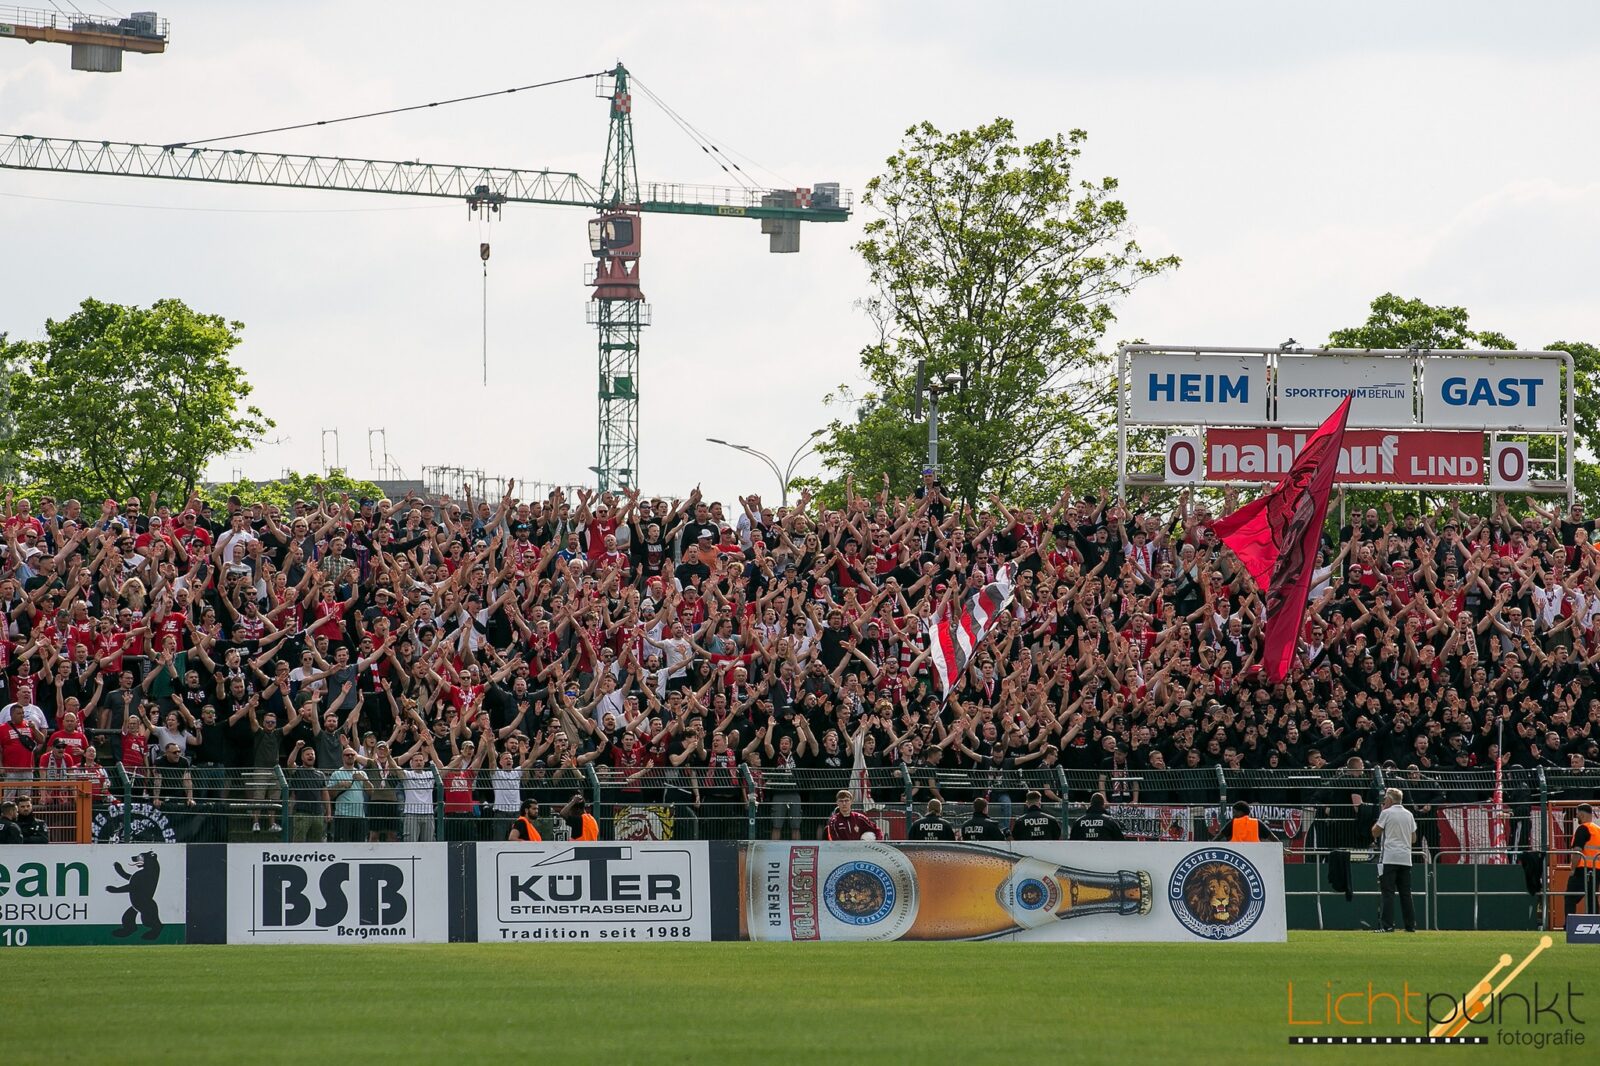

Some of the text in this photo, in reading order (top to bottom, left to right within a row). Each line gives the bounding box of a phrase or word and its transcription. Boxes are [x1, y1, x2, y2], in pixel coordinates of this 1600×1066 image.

[1148, 373, 1249, 403] HEIM
[1285, 388, 1405, 399] SPORTFORUM BERLIN
[1441, 376, 1544, 407] GAST
[1169, 441, 1196, 477] 0
[1211, 433, 1478, 477] nahauf LIND
[1498, 446, 1525, 482] 0
[920, 823, 943, 831] POLIZEI
[965, 825, 983, 834] POLIZEI
[1024, 818, 1048, 826] POLIZEI
[1081, 819, 1104, 827] POLIZEI
[262, 851, 336, 863] Bauservice
[510, 847, 681, 902] KÜTER
[1173, 852, 1260, 893] DEUTSCHES PILSENER
[262, 862, 408, 927] BSB
[768, 862, 782, 927] PILSENER
[0, 903, 88, 921] BRUCH
[510, 904, 683, 915] STEINSTRASSENBAU
[2, 928, 28, 946] 10
[337, 925, 407, 939] Bergmann
[500, 926, 692, 939] Tradition seit 1988
